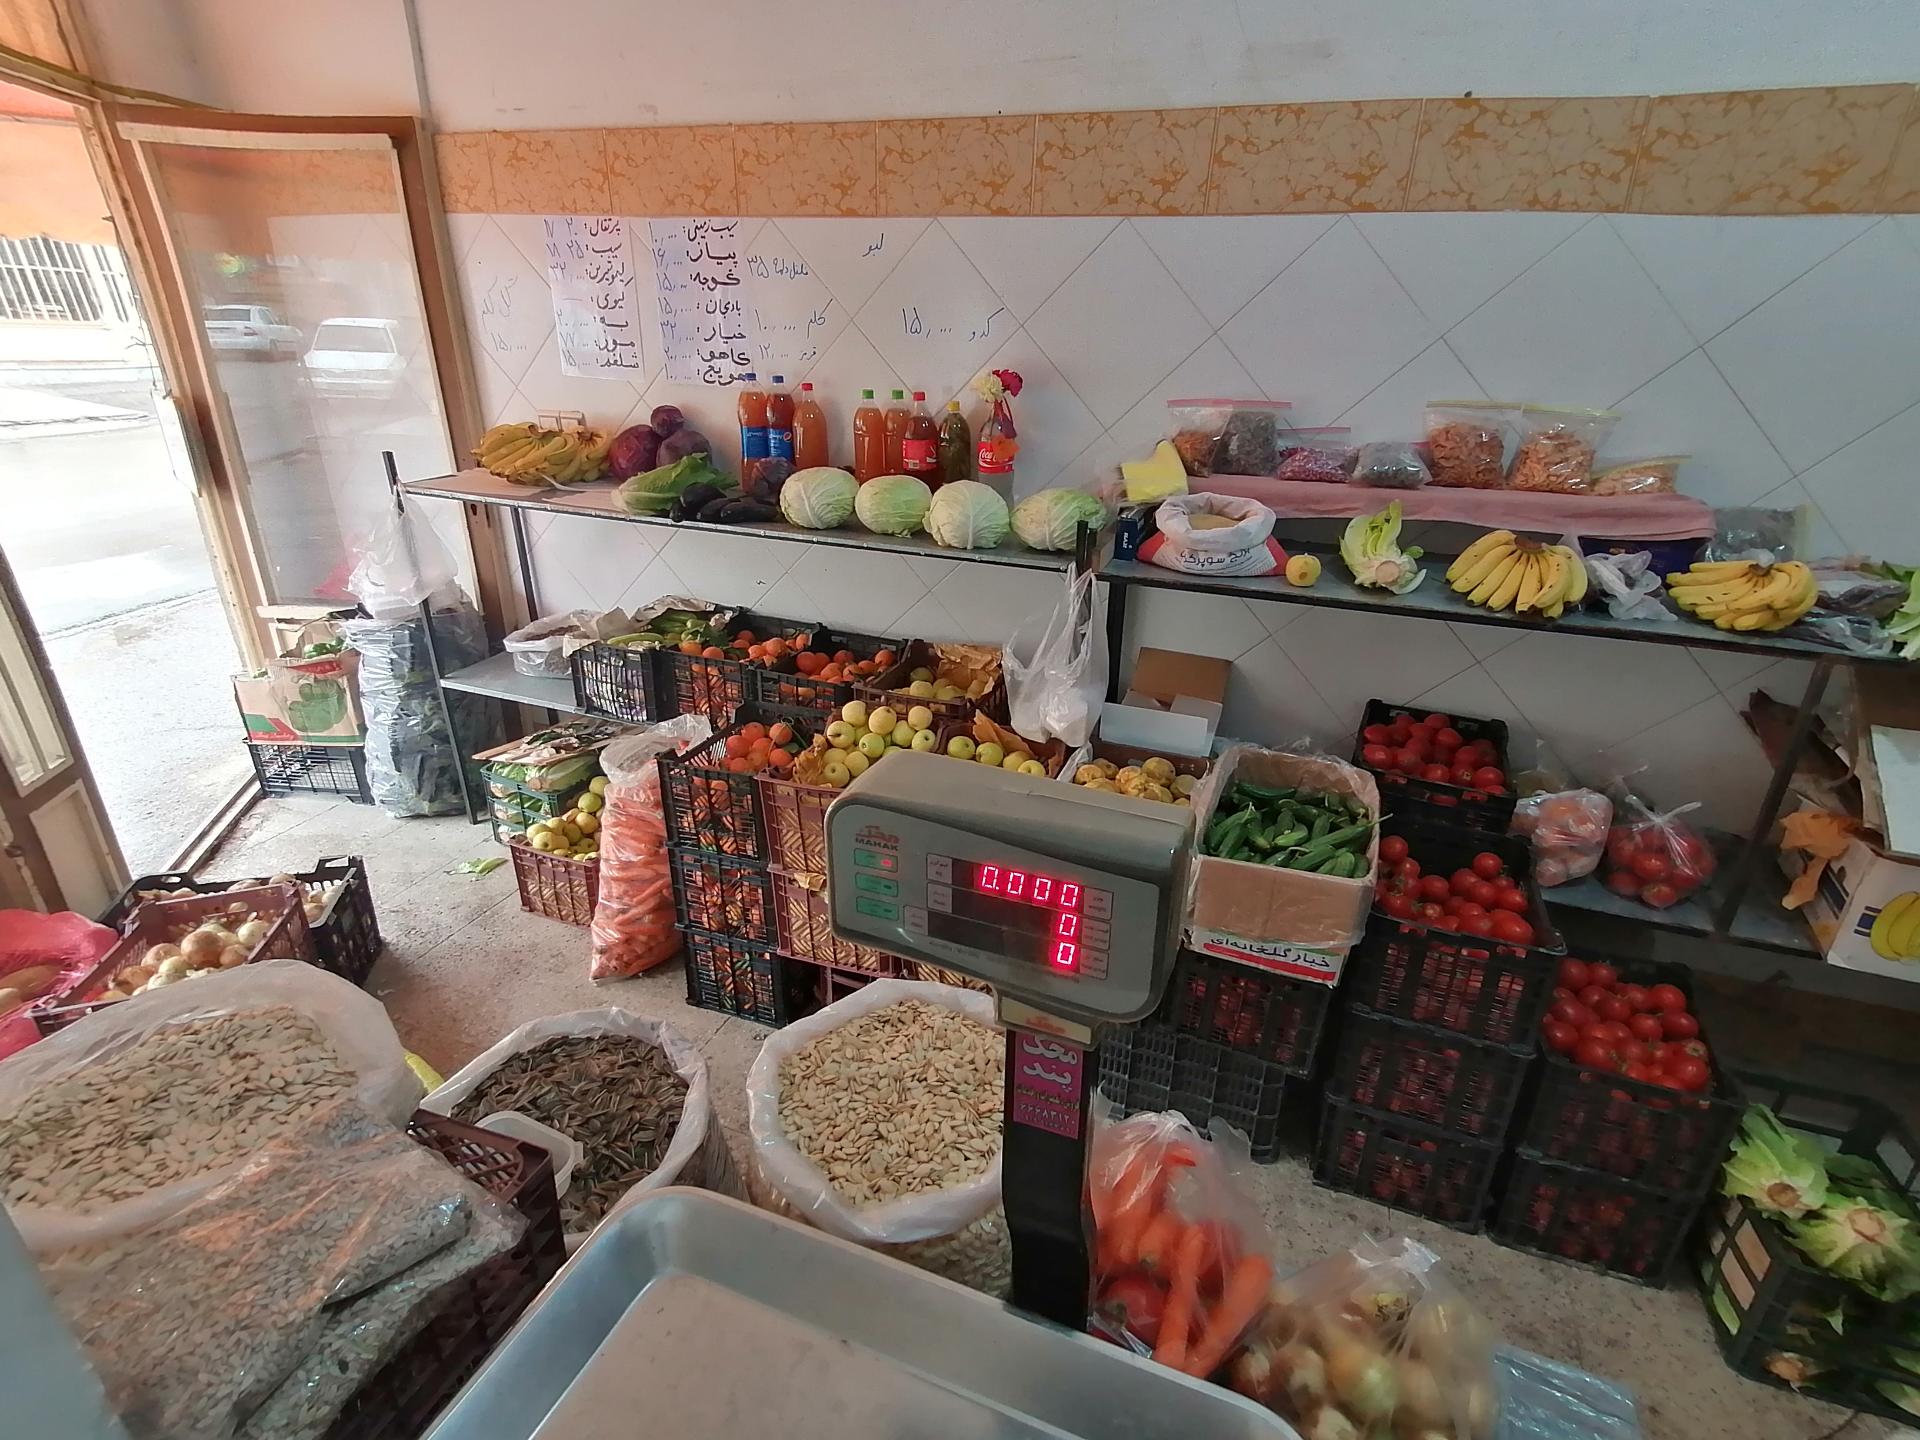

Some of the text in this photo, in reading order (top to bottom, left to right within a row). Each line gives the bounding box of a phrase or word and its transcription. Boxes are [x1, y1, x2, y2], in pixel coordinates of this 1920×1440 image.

[855, 837, 899, 852] MAHAK
[980, 865, 1079, 908] 0.000
[1058, 912, 1077, 937] 0
[1056, 941, 1076, 965] 0
[1291, 951, 1331, 969] خیار
